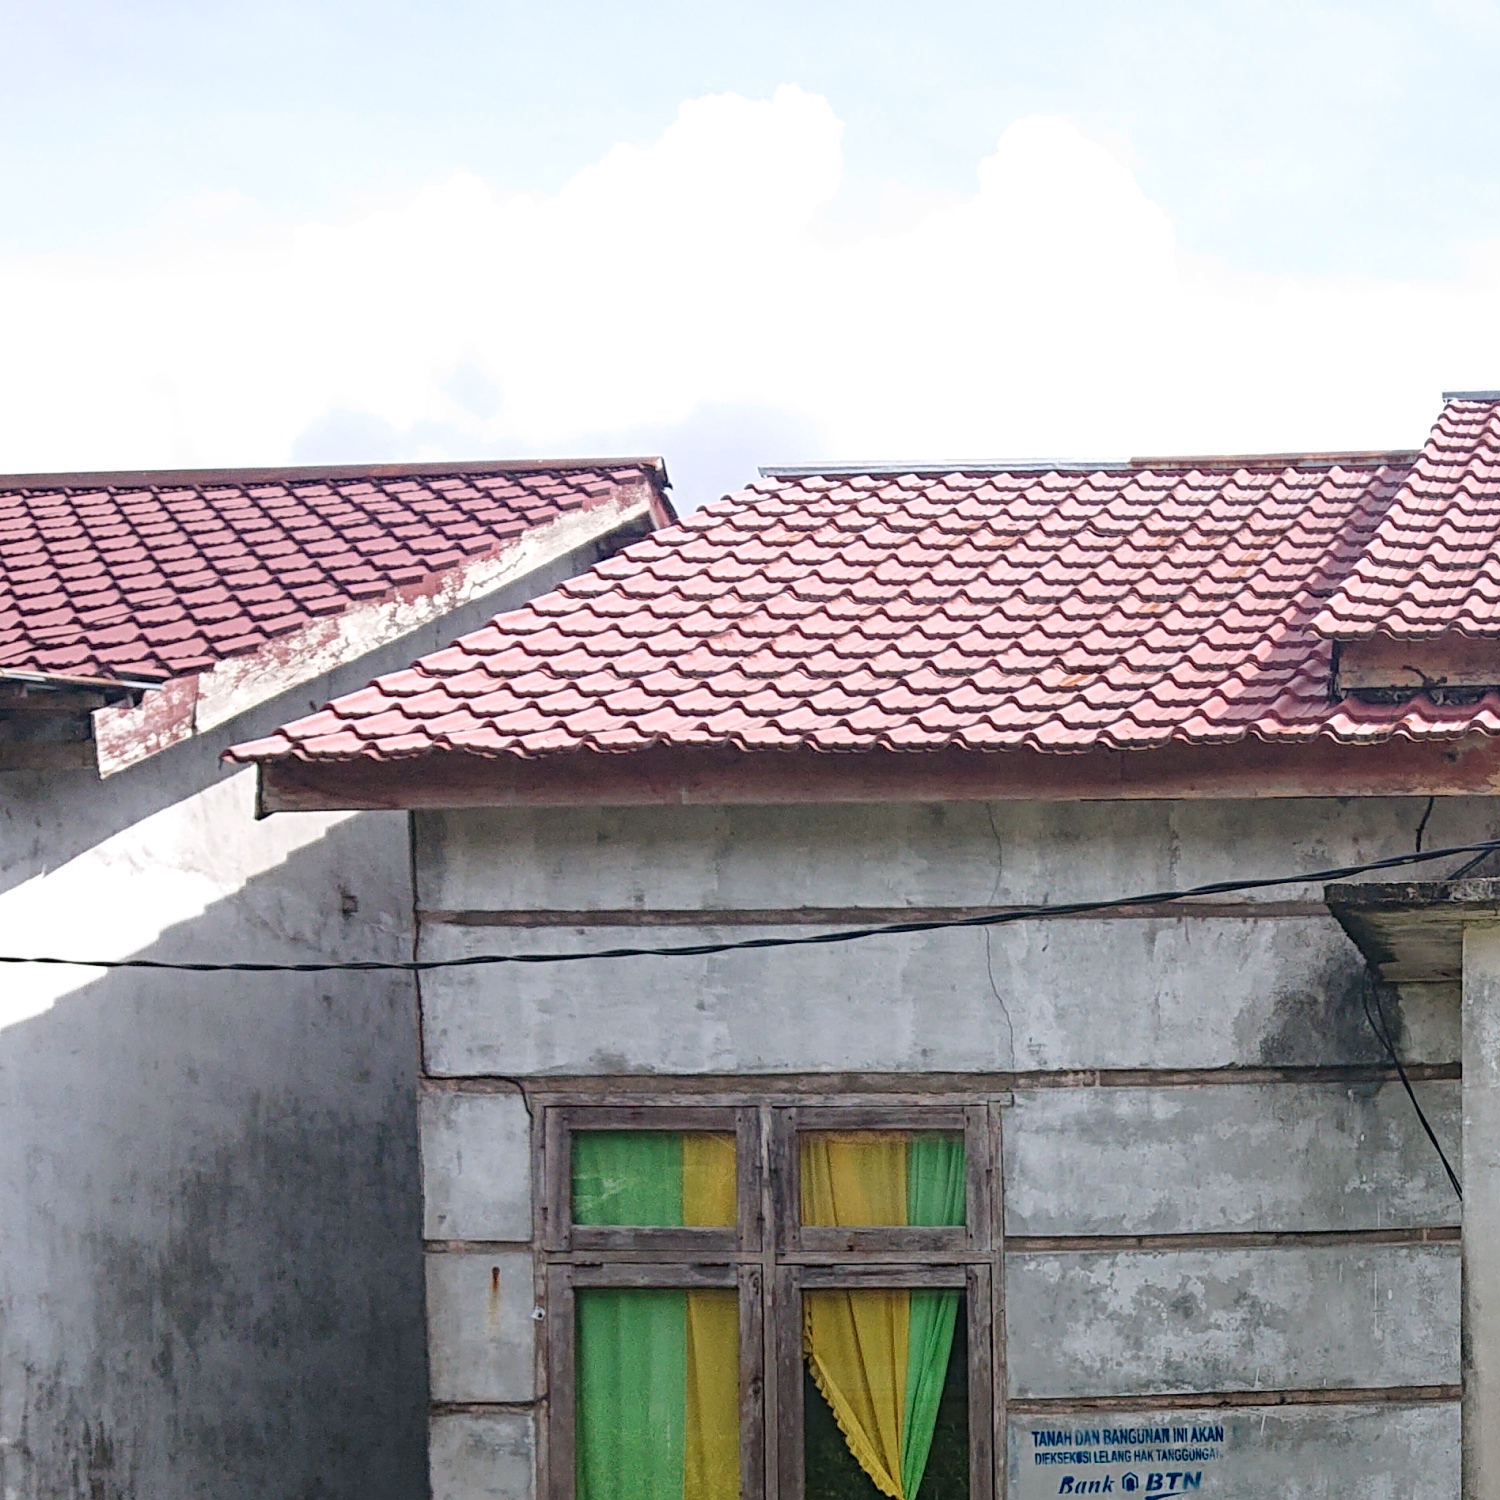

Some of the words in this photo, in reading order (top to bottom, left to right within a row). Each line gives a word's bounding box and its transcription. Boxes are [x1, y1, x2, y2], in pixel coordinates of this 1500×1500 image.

[1032, 1430, 1072, 1448] TANAH
[1076, 1428, 1100, 1445] DAN
[1103, 1428, 1169, 1444] BANGUNAN
[1173, 1427, 1188, 1443] INI
[1191, 1426, 1224, 1443] AKAN
[1034, 1451, 1092, 1465] DIEKSEKUSI
[1094, 1450, 1131, 1464] LELANG
[1134, 1448, 1154, 1462] HAK
[1058, 1474, 1115, 1494] Bank
[1145, 1471, 1202, 1492] BTN
